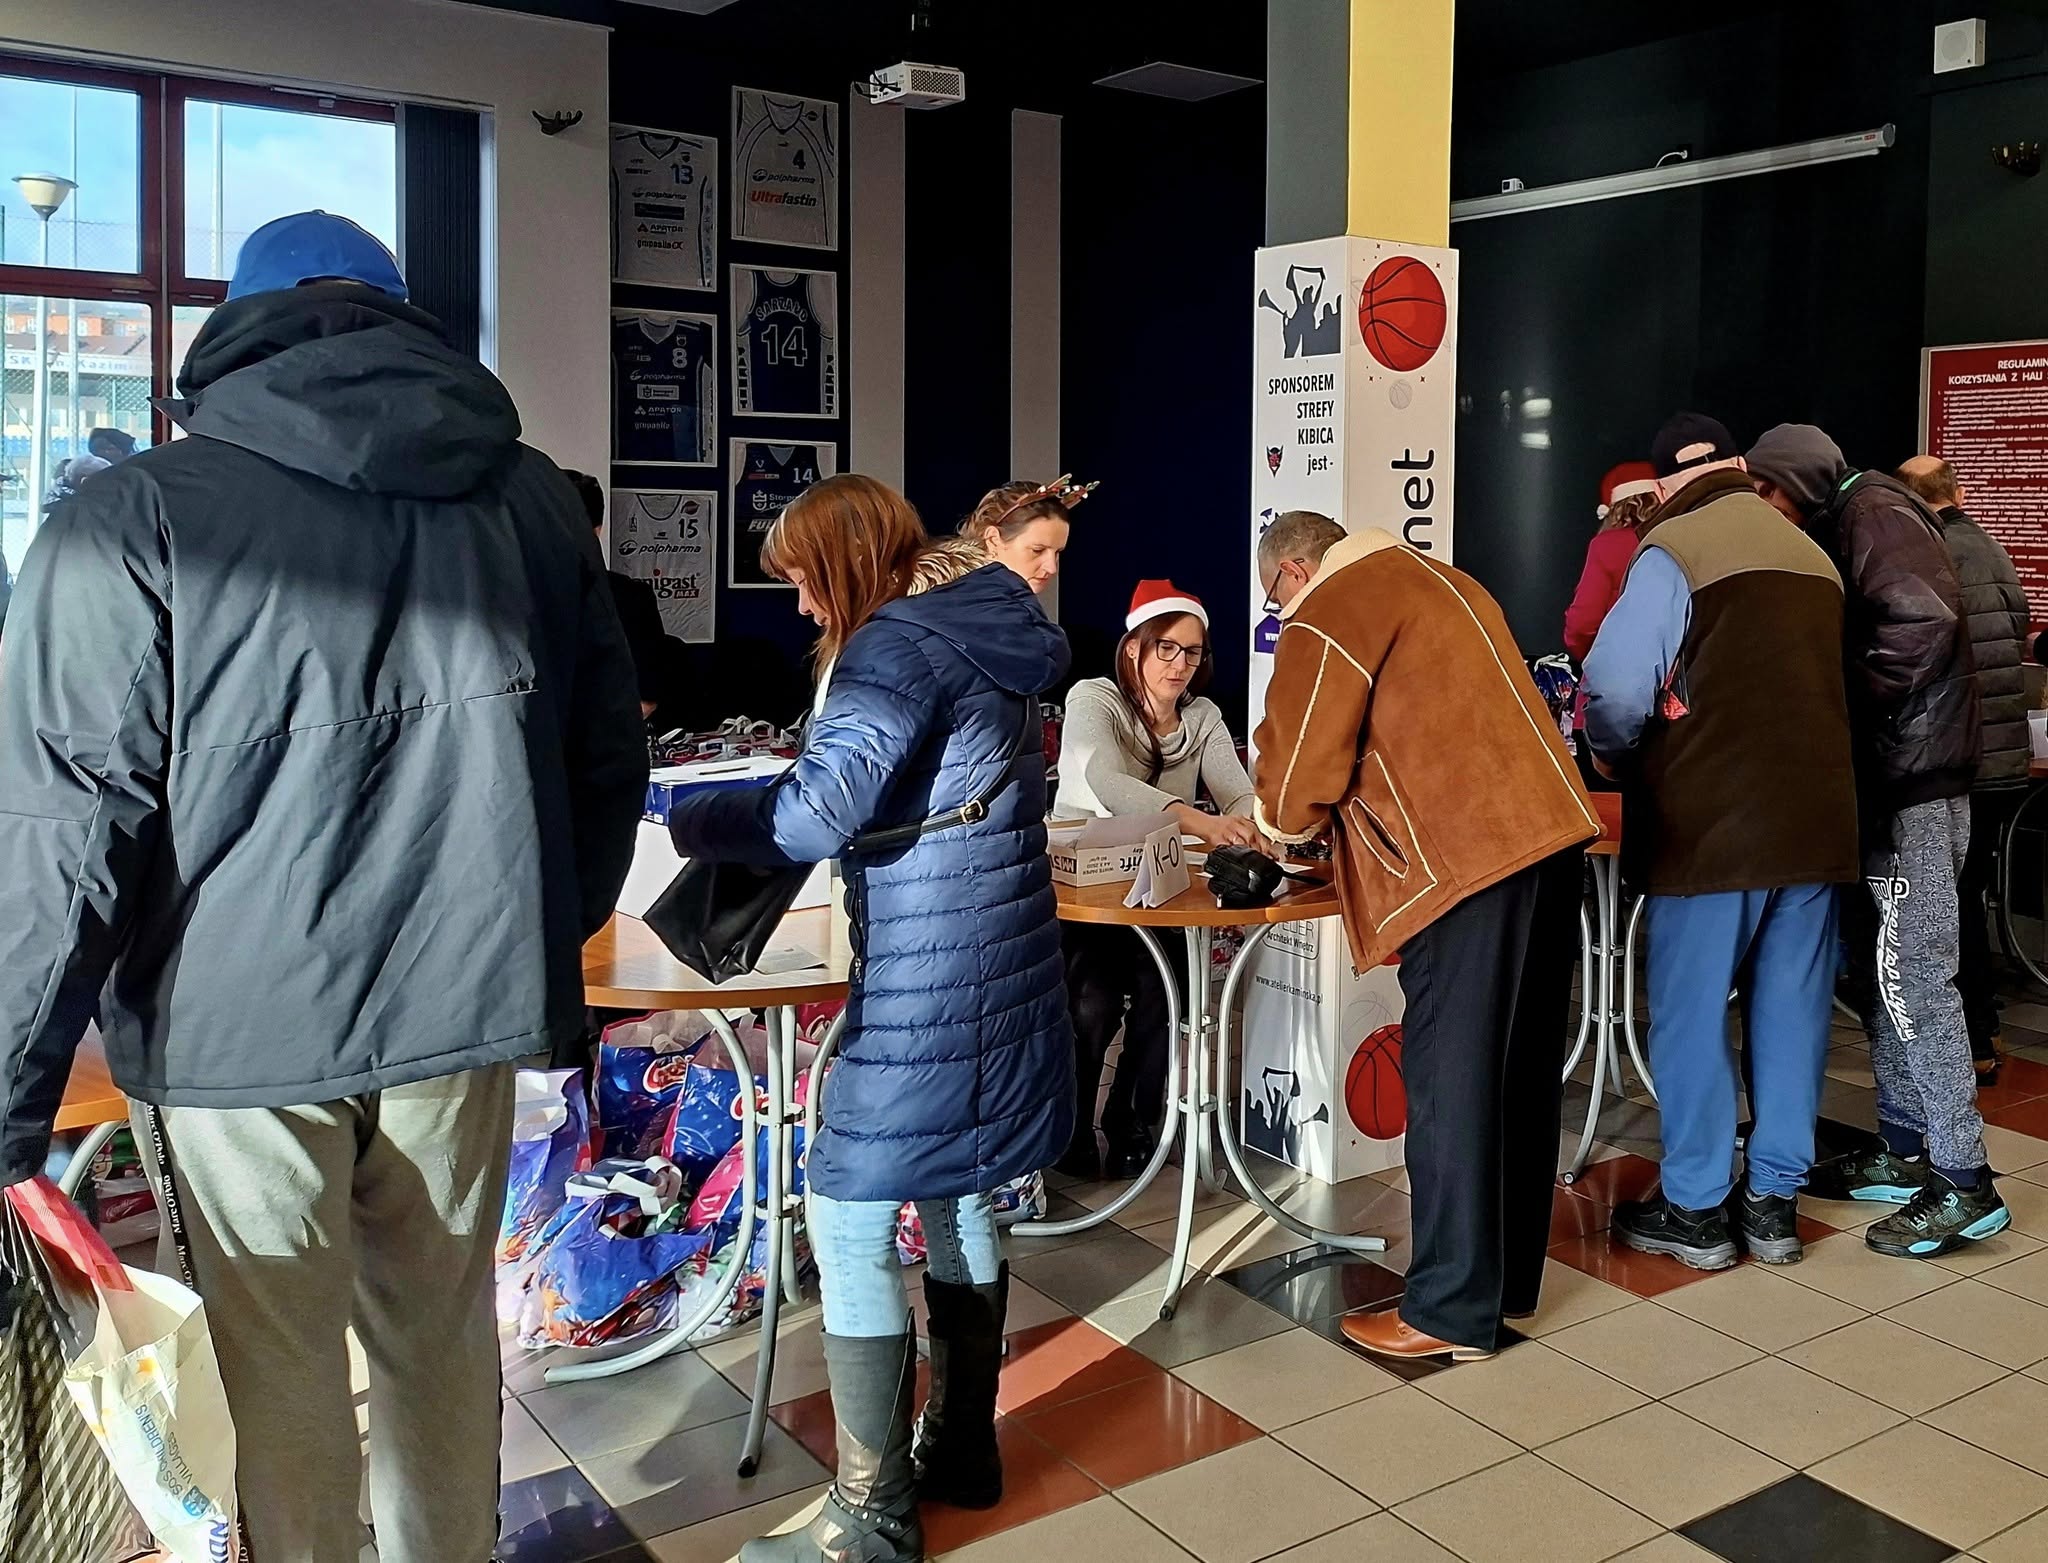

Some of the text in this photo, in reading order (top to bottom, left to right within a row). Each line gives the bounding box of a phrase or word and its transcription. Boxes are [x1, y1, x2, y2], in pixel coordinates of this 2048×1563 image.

[793, 149, 806, 169] 4
[671, 164, 693, 184] 13
[751, 191, 817, 207] Ultrafastin
[761, 324, 808, 367] 14
[672, 347, 688, 369] 8
[1268, 373, 1334, 395] SPONSOREM
[1948, 373, 2007, 385] KORZYSTANIA
[2011, 373, 2018, 382] Z
[1297, 400, 1335, 419] STREFY
[1298, 427, 1334, 445] KIBICA
[793, 467, 814, 484] 14
[678, 518, 698, 539] 15
[638, 543, 702, 555] polpharma
[676, 590, 697, 598] MAX
[1152, 836, 1179, 876] K-O
